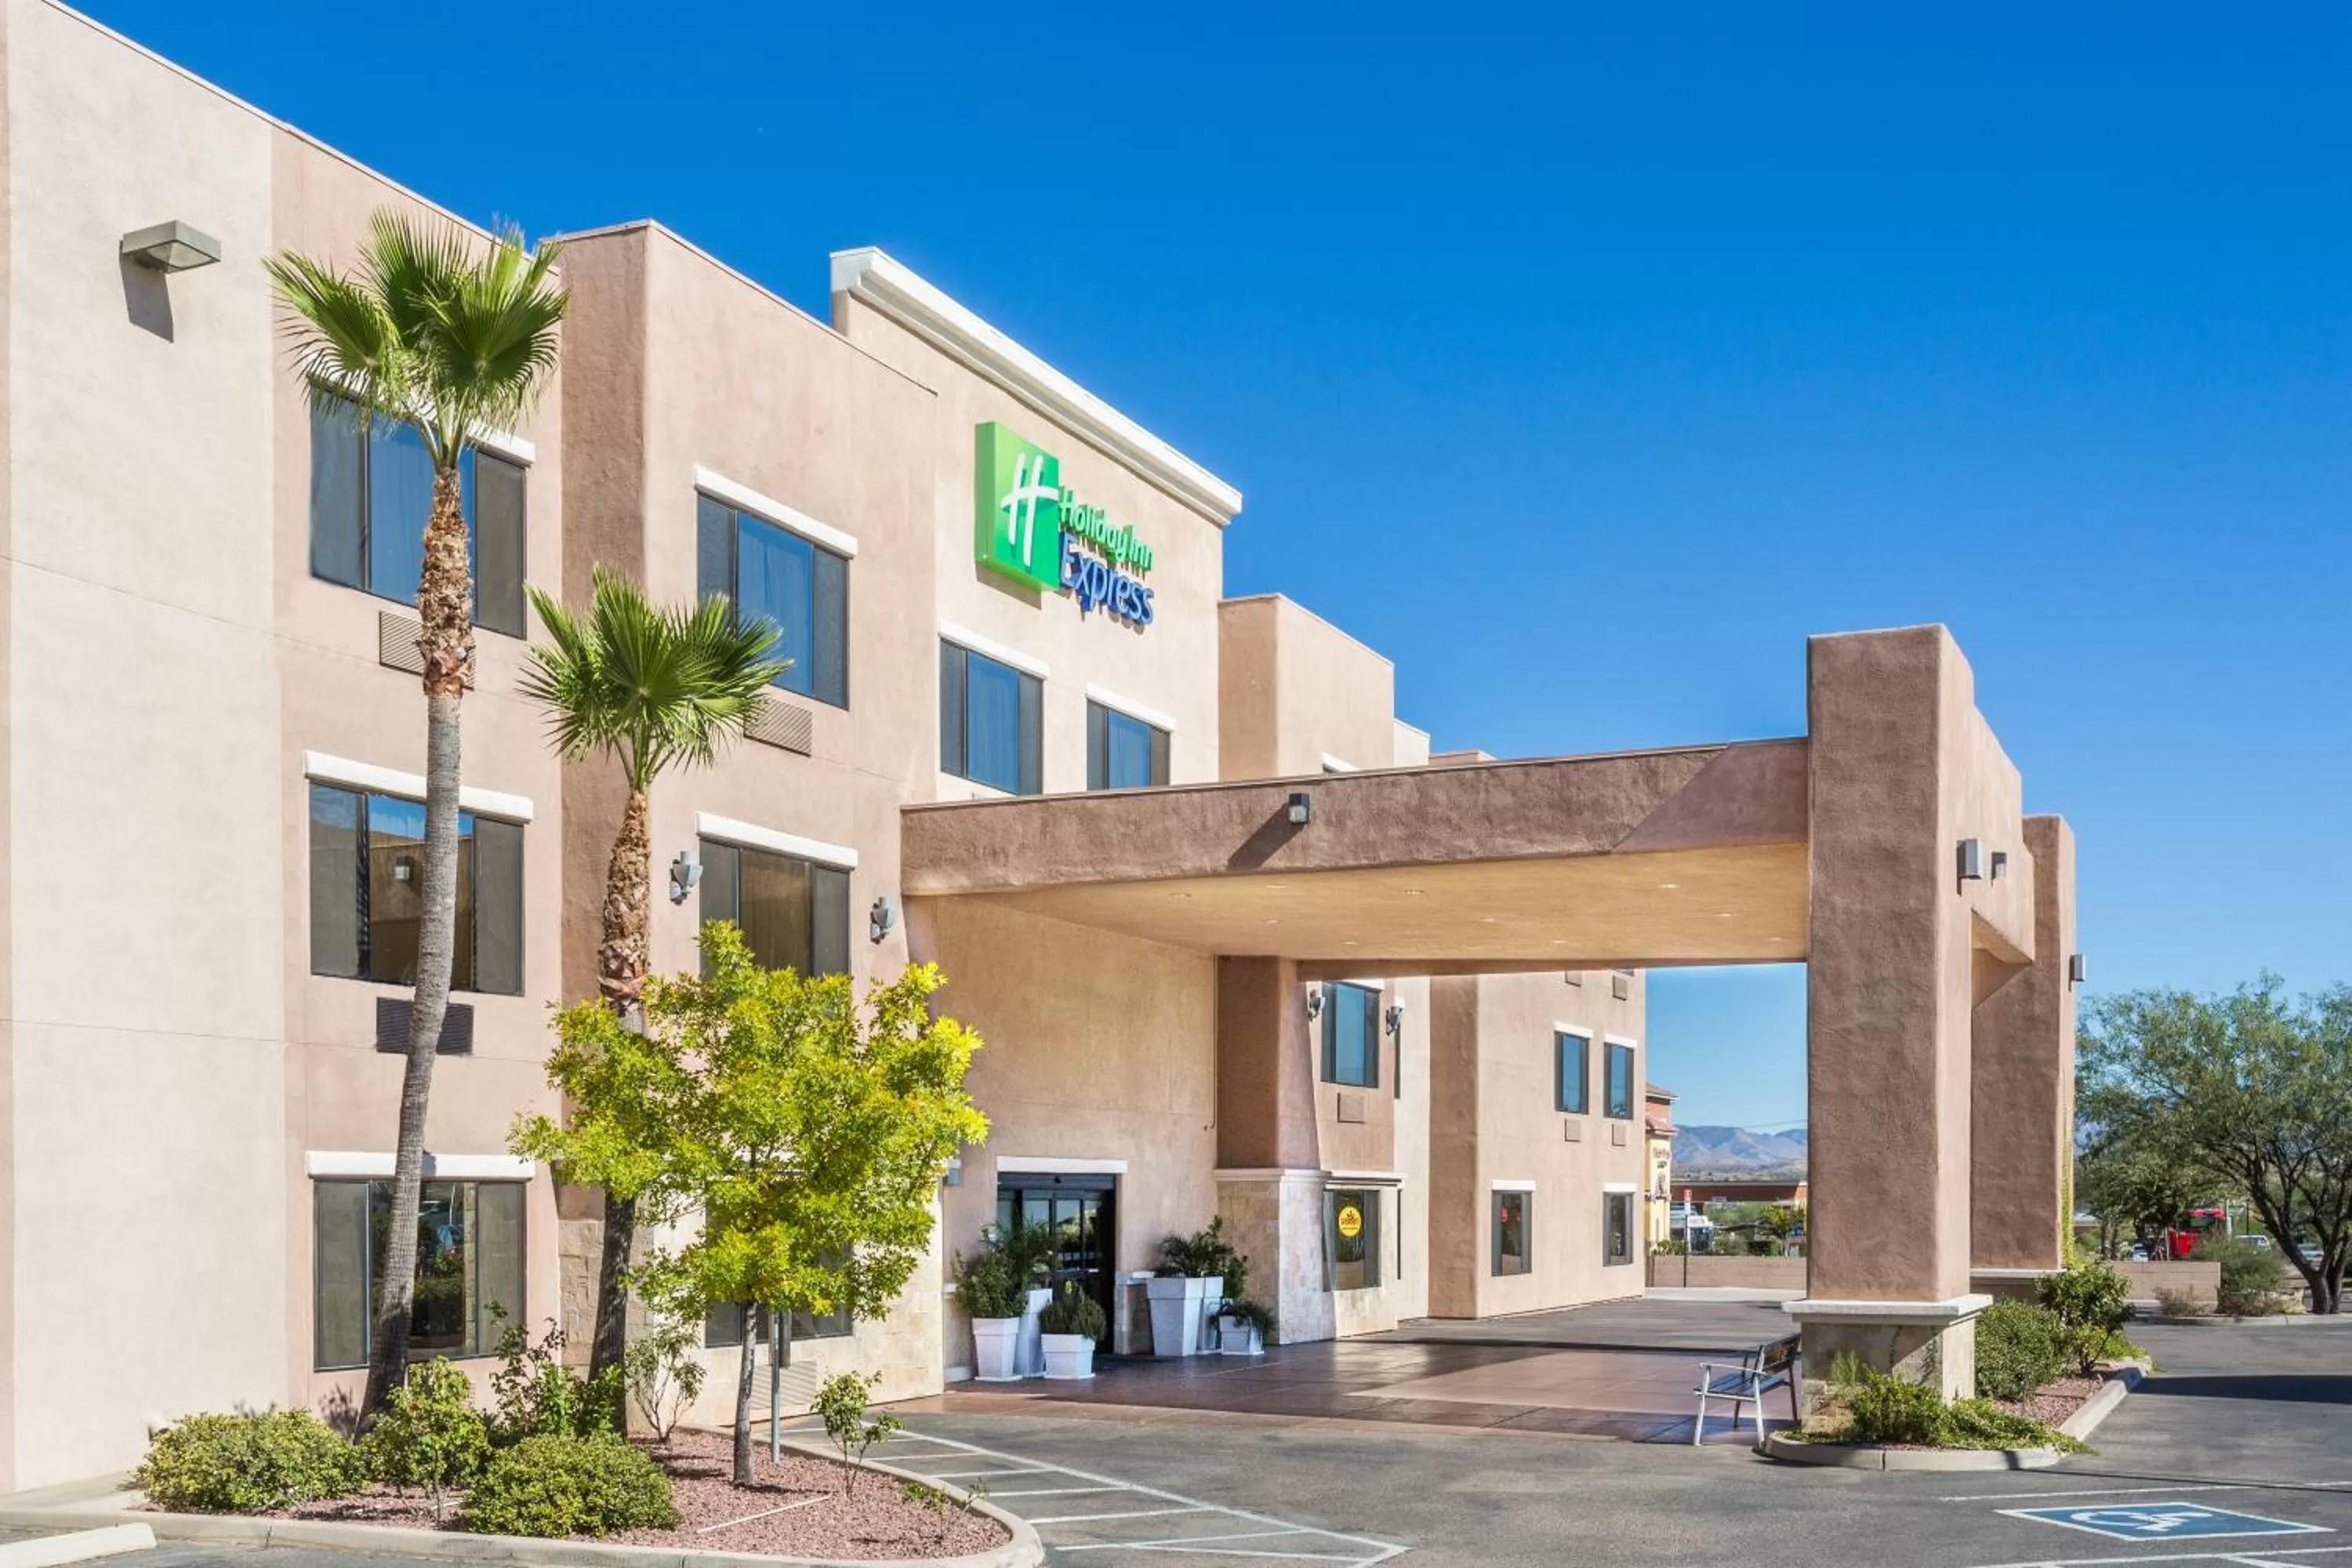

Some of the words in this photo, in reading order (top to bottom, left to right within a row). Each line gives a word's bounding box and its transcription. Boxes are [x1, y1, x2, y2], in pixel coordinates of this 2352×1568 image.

[1059, 485, 1128, 563] Holiday
[1129, 524, 1155, 572] Inn
[1060, 532, 1155, 626] Express
